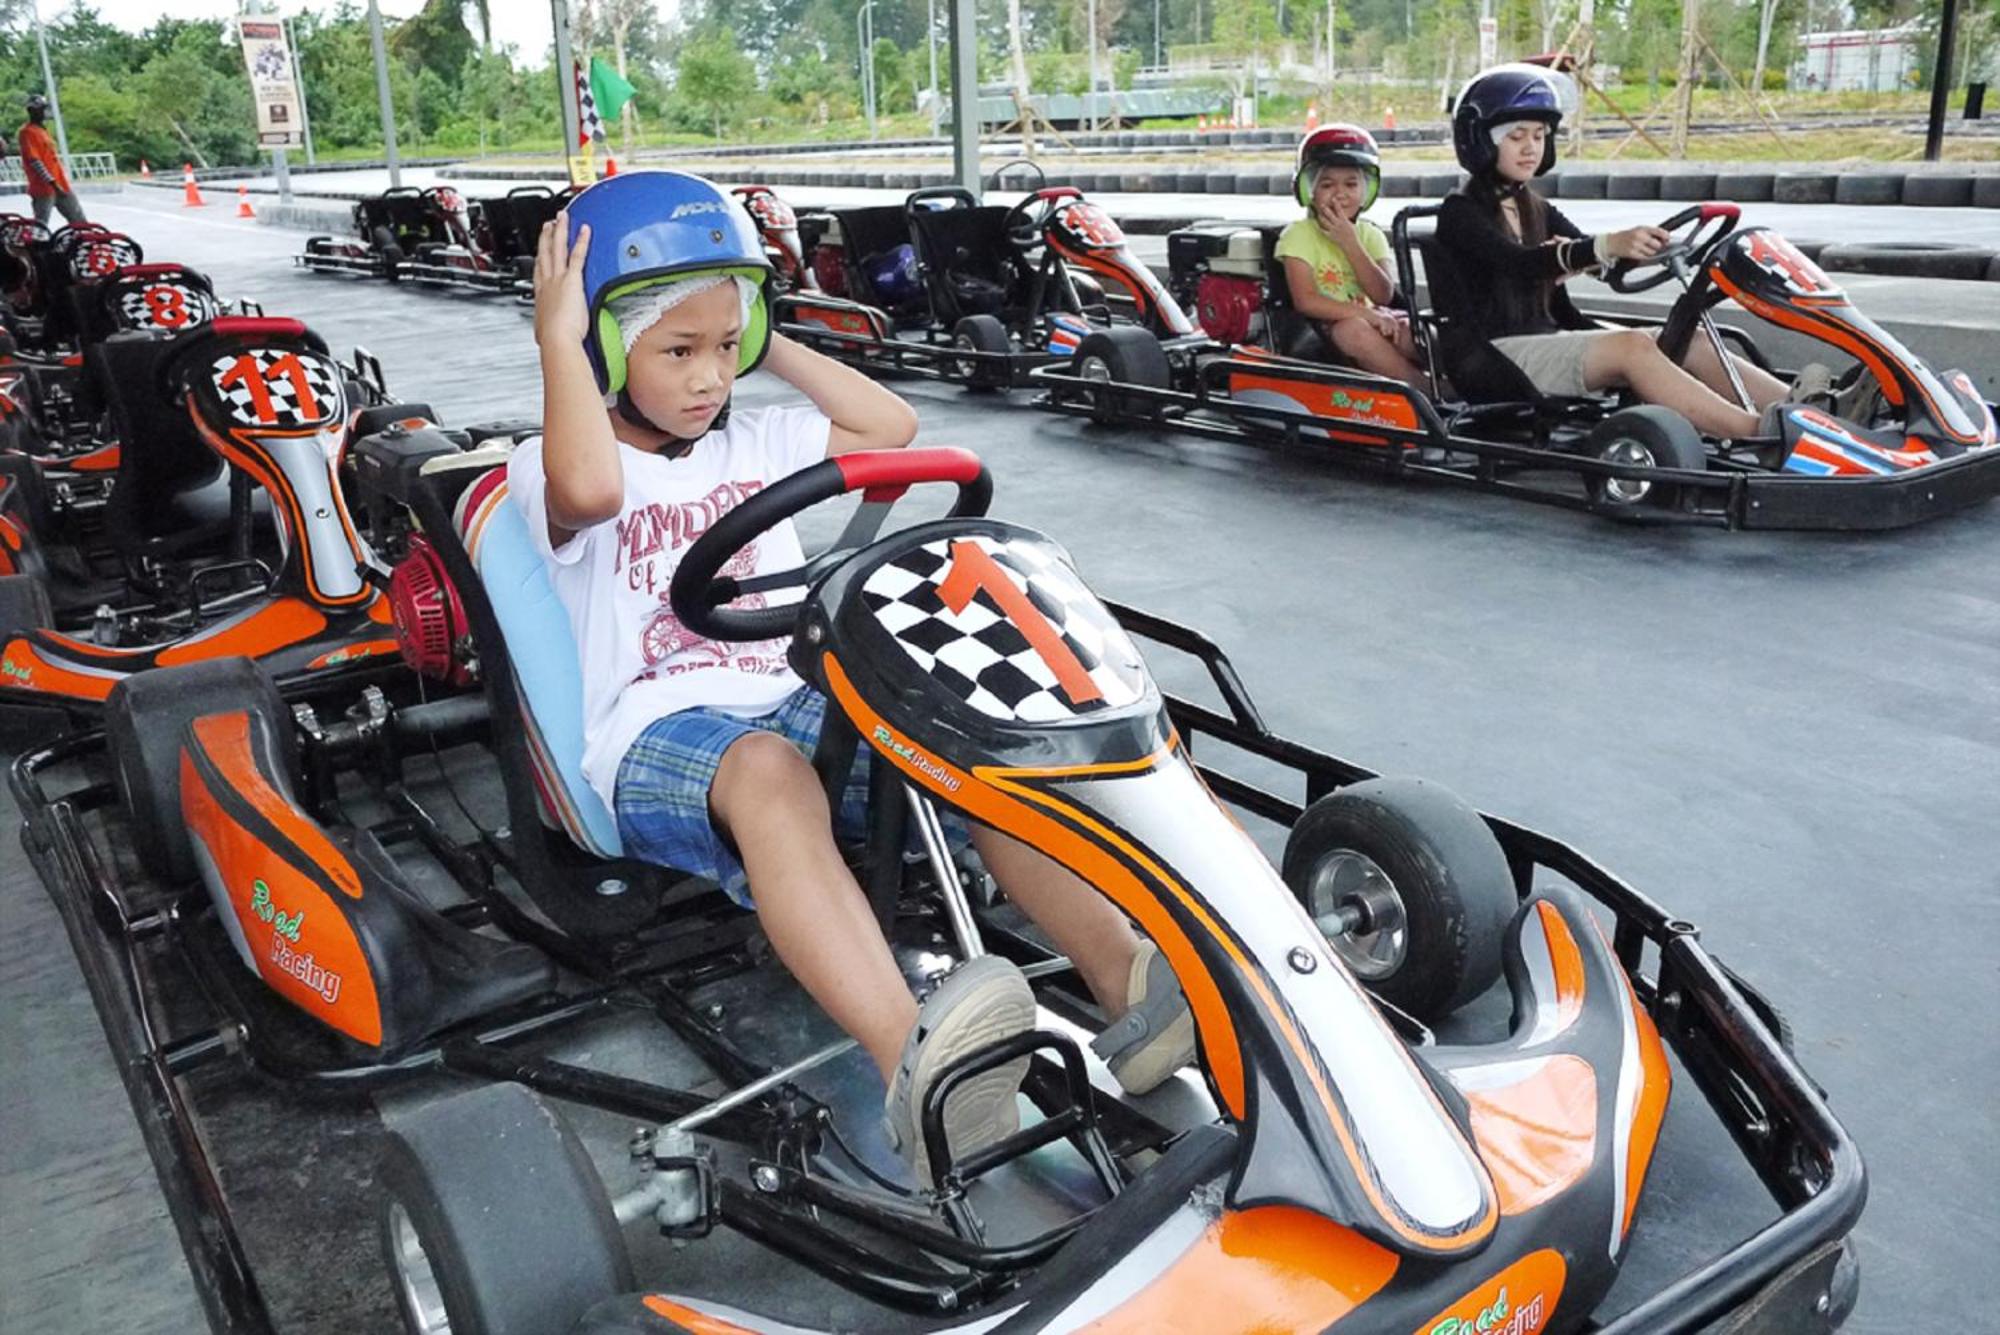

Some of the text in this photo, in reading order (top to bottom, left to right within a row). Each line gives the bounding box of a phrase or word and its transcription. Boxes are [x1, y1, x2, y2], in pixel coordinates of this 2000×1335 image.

[88, 243, 117, 274] 6
[144, 286, 188, 328] 8
[220, 354, 320, 422] 11
[934, 540, 1104, 704] 1
[873, 724, 915, 760] Road
[251, 879, 304, 942] Road
[271, 932, 341, 1004] Racing
